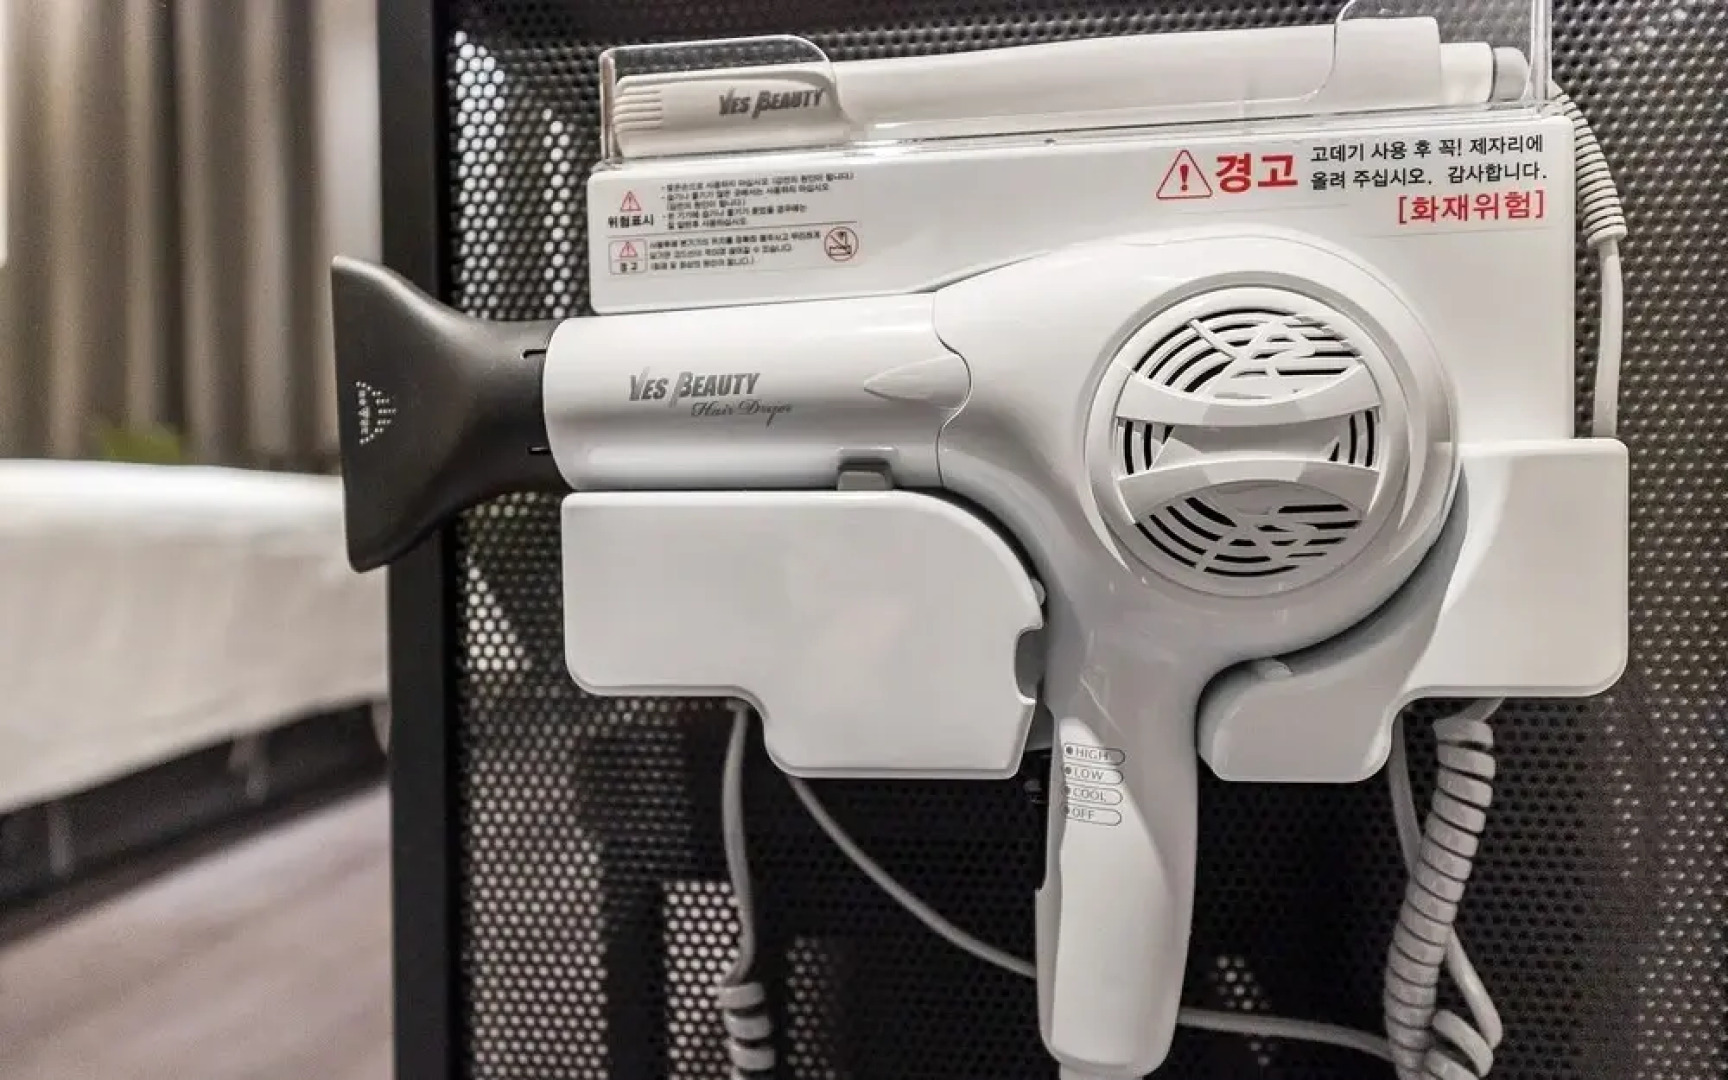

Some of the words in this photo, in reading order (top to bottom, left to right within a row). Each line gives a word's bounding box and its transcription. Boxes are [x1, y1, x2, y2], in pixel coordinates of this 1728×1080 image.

[719, 87, 751, 115] YES
[752, 88, 827, 119] BEAUTY
[1311, 143, 1364, 162] 고데기
[1371, 141, 1408, 160] 사용
[1414, 139, 1432, 158] 후
[1438, 137, 1463, 157] 꼭!
[1468, 134, 1543, 155] 제자리에
[1215, 151, 1299, 193] 경고
[1311, 170, 1346, 191] 올려
[1352, 167, 1433, 189] 주십시오.
[1447, 161, 1548, 185] 감사합니다.
[1398, 189, 1545, 225] [화재위험]
[629, 366, 669, 402] YES
[668, 371, 761, 409] BEAUTY
[690, 401, 734, 418] Hair
[737, 399, 794, 428] Dryer
[1076, 747, 1109, 761] HIGH
[1074, 767, 1105, 780] LOW
[1072, 787, 1107, 803] COOL
[1071, 807, 1095, 820] OFF
